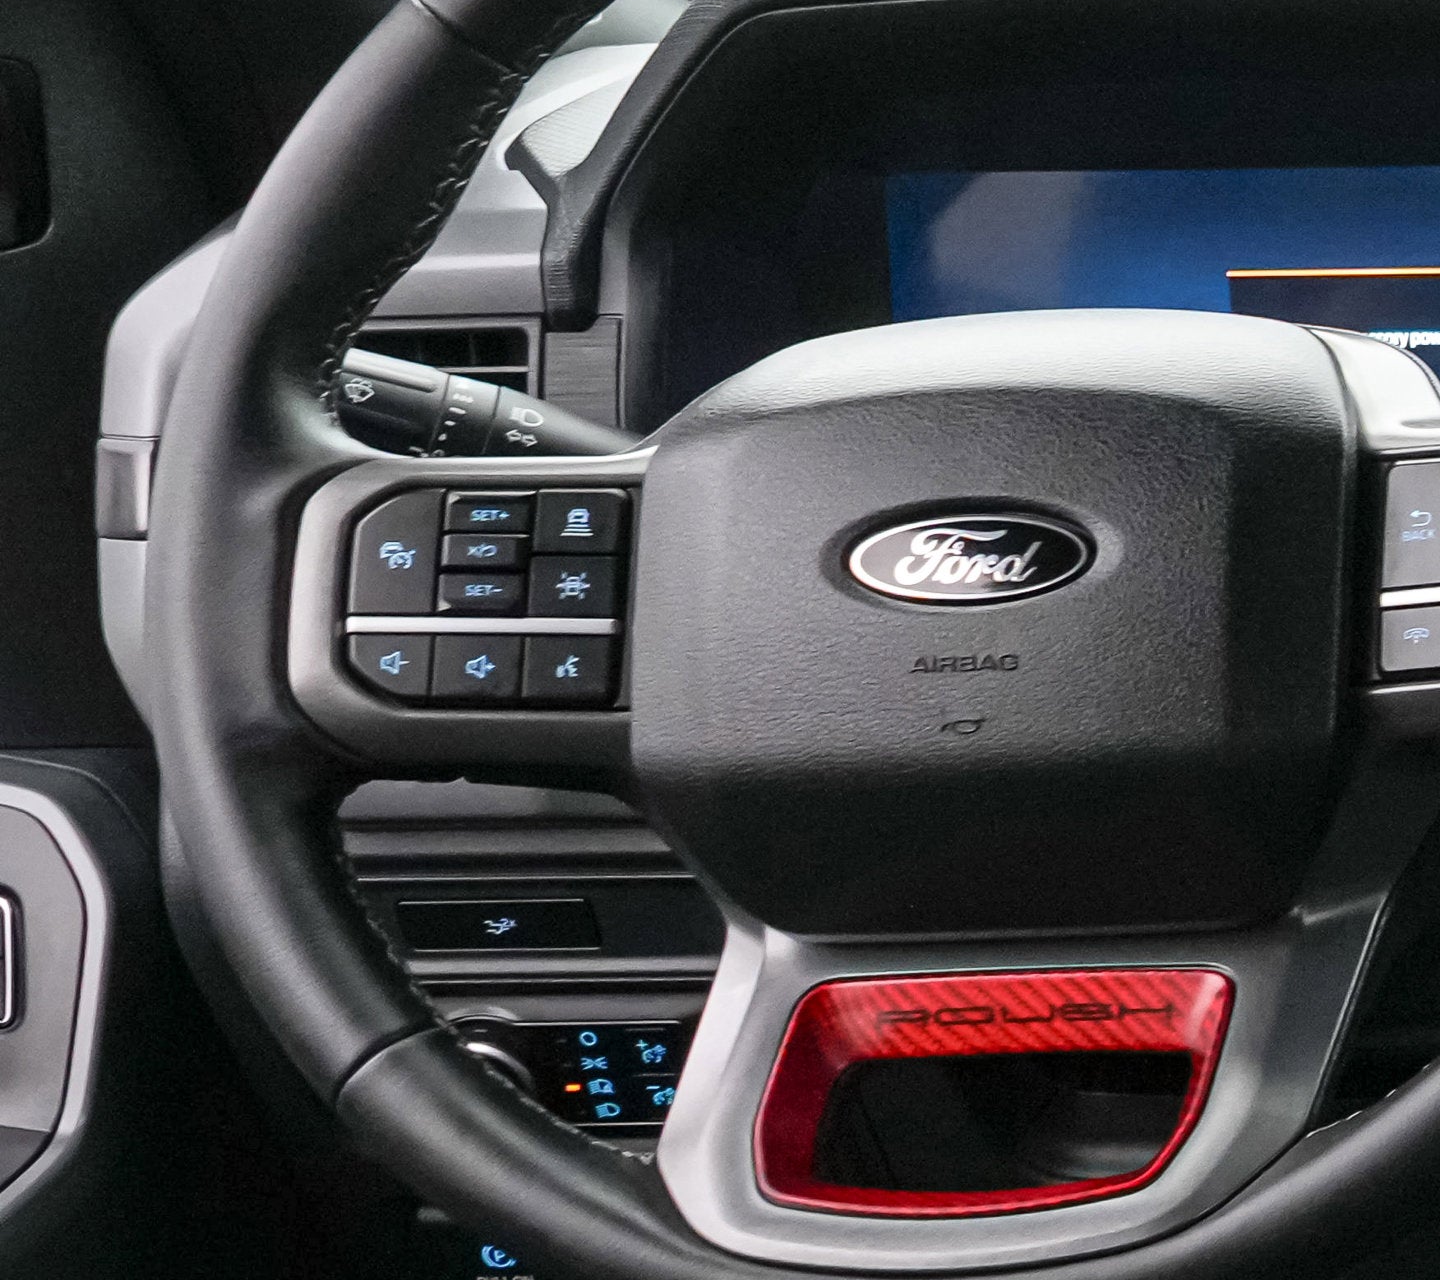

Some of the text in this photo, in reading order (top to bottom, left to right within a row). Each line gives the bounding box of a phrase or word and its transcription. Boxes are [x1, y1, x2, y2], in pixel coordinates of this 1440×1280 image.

[894, 527, 1042, 586] Ford
[910, 654, 1020, 673] AIRBAG
[878, 1002, 1175, 1030] ROUSH
